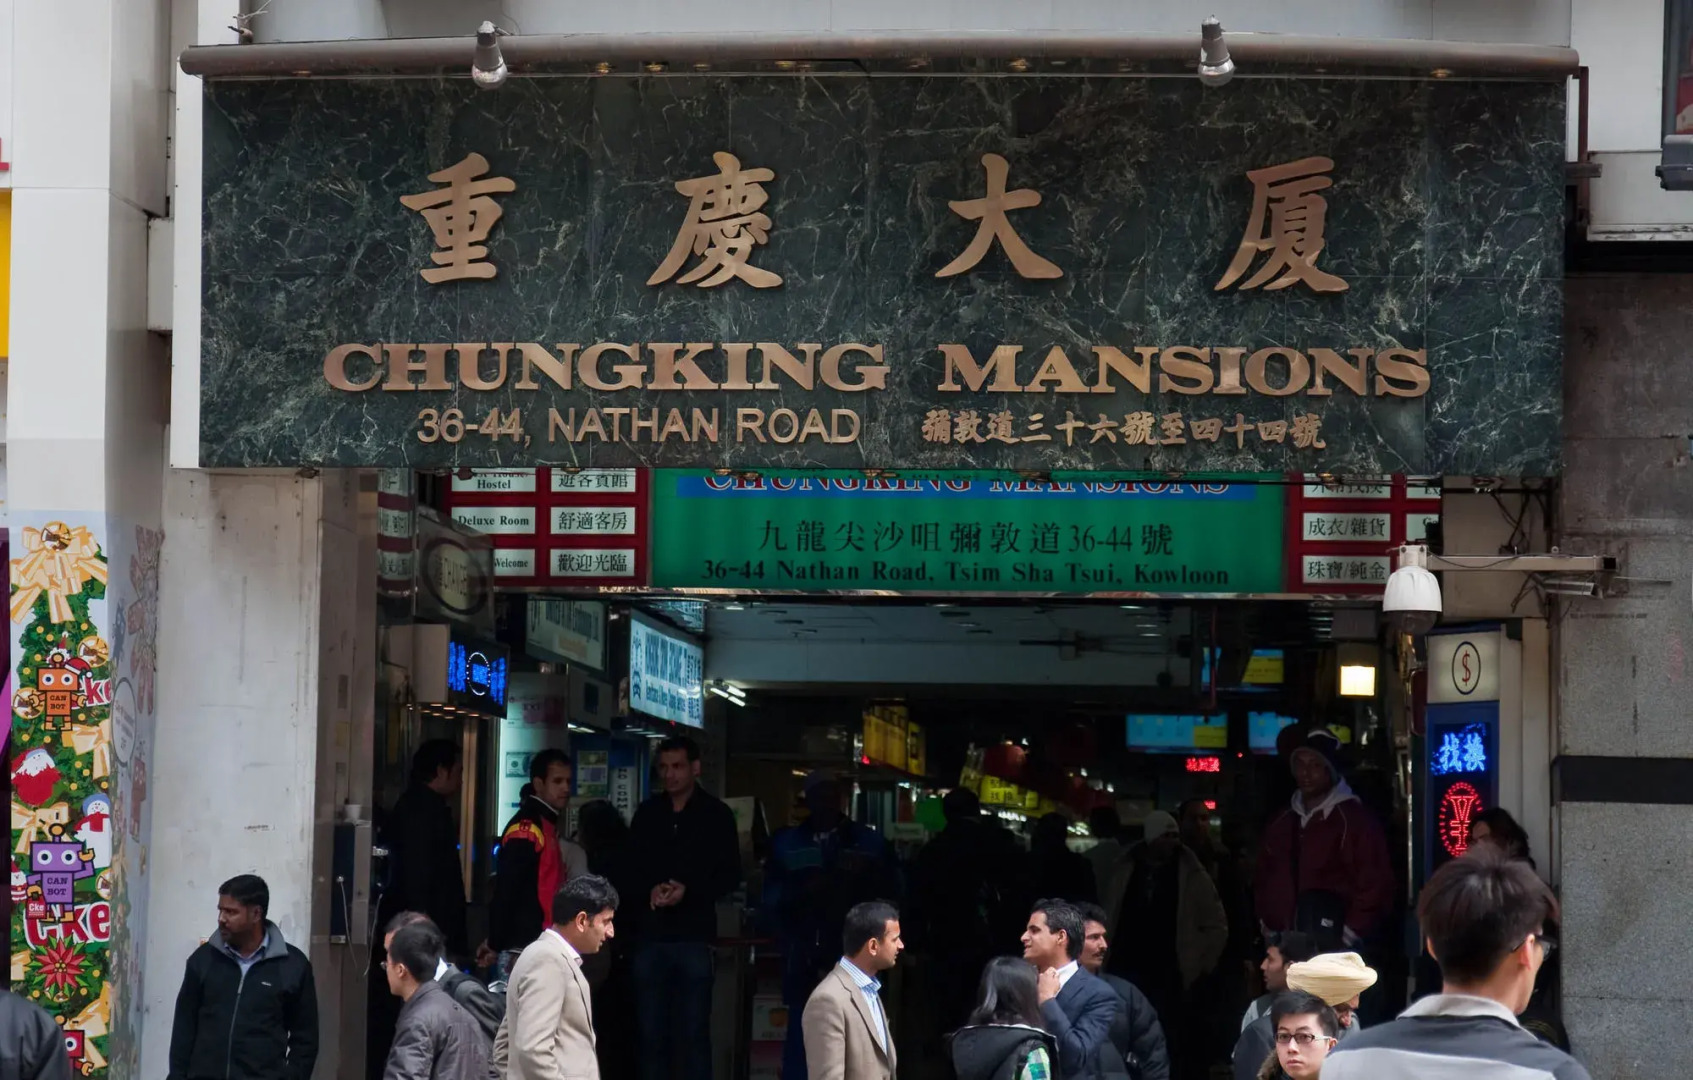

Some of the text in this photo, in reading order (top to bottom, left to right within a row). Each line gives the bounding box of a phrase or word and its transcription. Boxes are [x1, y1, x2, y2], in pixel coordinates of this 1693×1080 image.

[323, 341, 1431, 398] CHUNGKING MANSIONS
[416, 407, 861, 447] 36-44, NATHAN ROAD
[477, 479, 511, 489] Hostel
[458, 515, 530, 526] Deluxe Room
[558, 511, 628, 530] 舒適客房
[1308, 517, 1386, 536] 成衣/雜貨
[757, 519, 1174, 556] 九龍尖沙咀彌敦道36-44號
[494, 557, 528, 568] Welcome
[557, 553, 628, 573] 歡迎光臨
[1307, 560, 1386, 580] 珠寶/純金
[701, 560, 1229, 585] 36-44 Nathan Road, Tsim Sha Tsui, Kowloon
[49, 694, 68, 702] CAN
[46, 876, 69, 885] CAN
[46, 887, 68, 896] BOT
